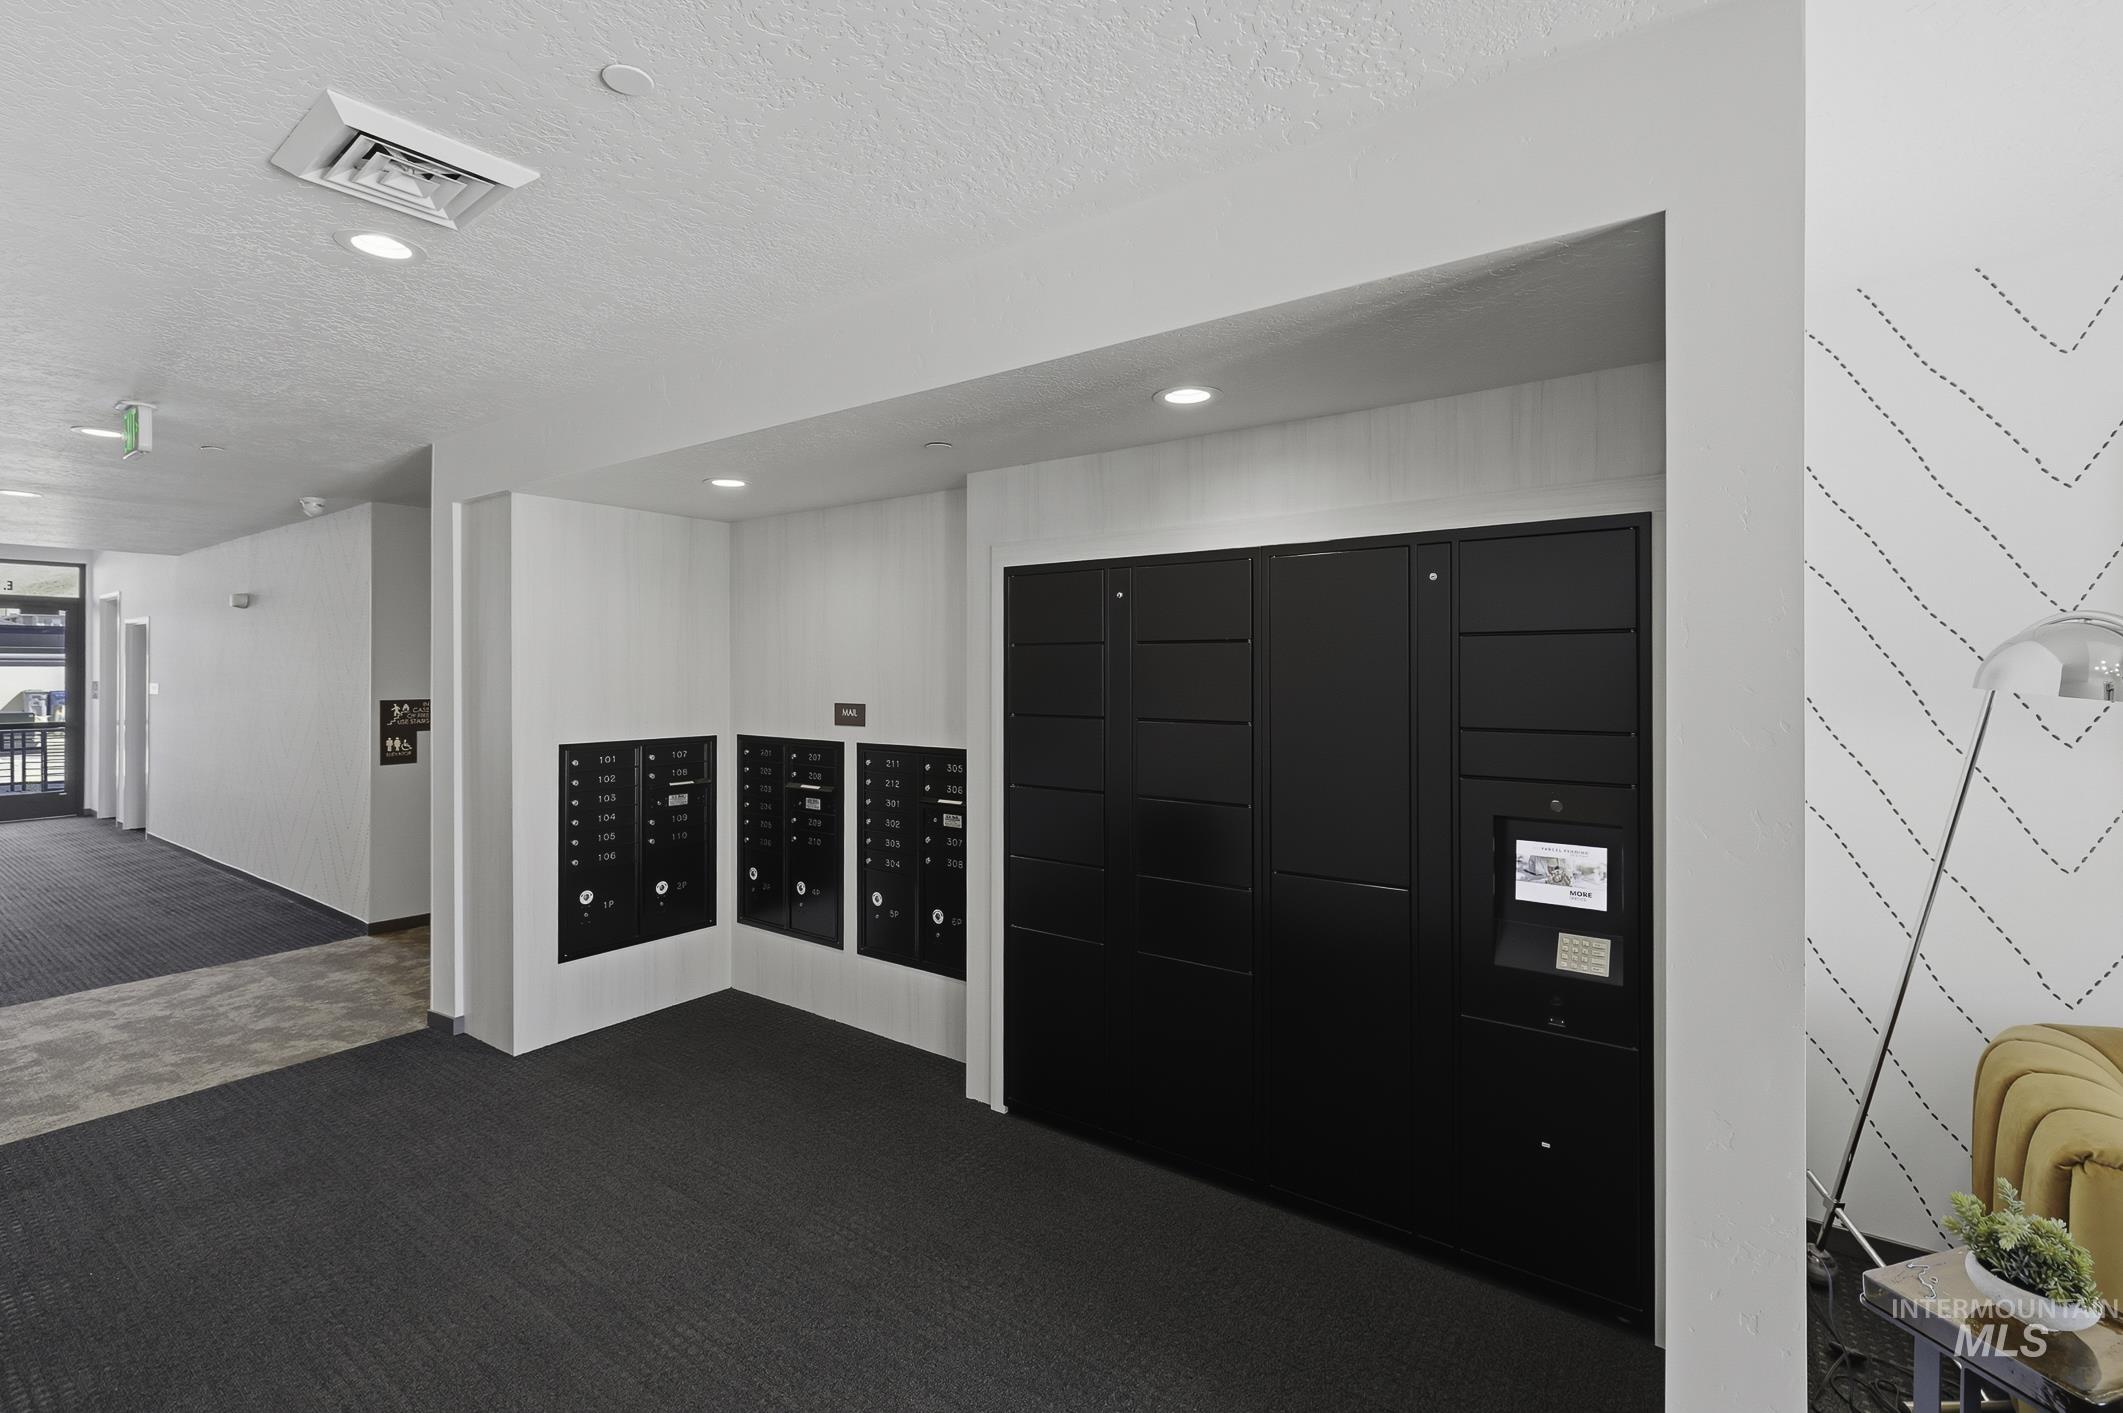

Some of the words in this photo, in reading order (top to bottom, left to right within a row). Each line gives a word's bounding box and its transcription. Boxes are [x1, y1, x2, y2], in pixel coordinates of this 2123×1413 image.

[842, 708, 858, 717] MAIL
[672, 750, 688, 759] 107
[808, 753, 822, 761] 207
[599, 755, 616, 764] 101
[886, 759, 900, 768] 211
[672, 768, 688, 776] 108
[946, 764, 963, 773] 305
[598, 774, 616, 783] 102
[808, 772, 822, 781] 208
[885, 779, 900, 788] 212
[946, 785, 963, 794] 306
[598, 793, 616, 803] 103
[885, 799, 900, 808] 301
[598, 813, 616, 822] 104
[671, 813, 688, 822] 109
[808, 818, 822, 827] 209
[885, 818, 900, 828] 302
[598, 832, 616, 841] 105
[672, 831, 688, 840] 110
[808, 837, 822, 846] 210
[885, 839, 901, 848] 303
[946, 837, 963, 847] 307
[598, 852, 616, 861] 106
[885, 859, 900, 868] 304
[676, 881, 688, 890] 2P
[1569, 890, 1593, 899] MORE
[603, 900, 615, 909] 1P
